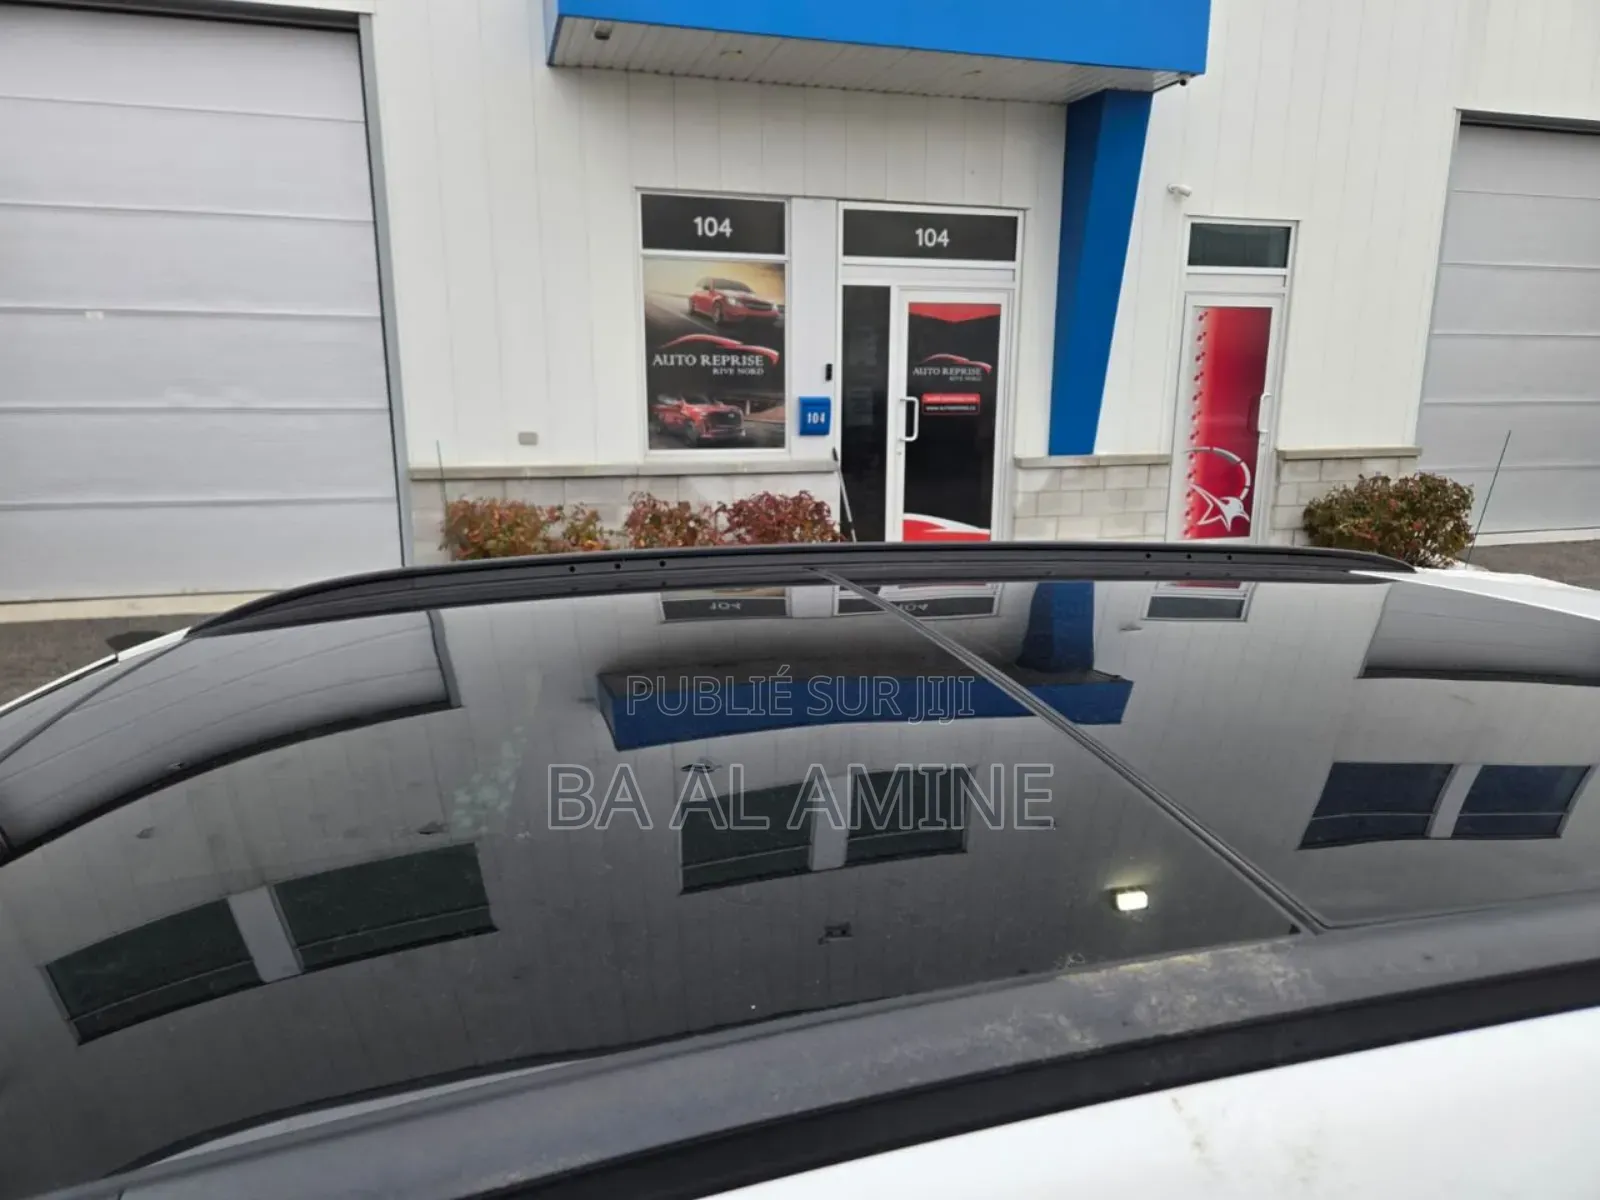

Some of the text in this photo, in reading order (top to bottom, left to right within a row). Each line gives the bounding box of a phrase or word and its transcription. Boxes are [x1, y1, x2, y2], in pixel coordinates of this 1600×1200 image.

[693, 216, 733, 238] 104
[915, 228, 950, 248] 104
[652, 353, 764, 367] AUTO REPRISE
[912, 367, 940, 376] AUTO
[807, 411, 826, 424] 104
